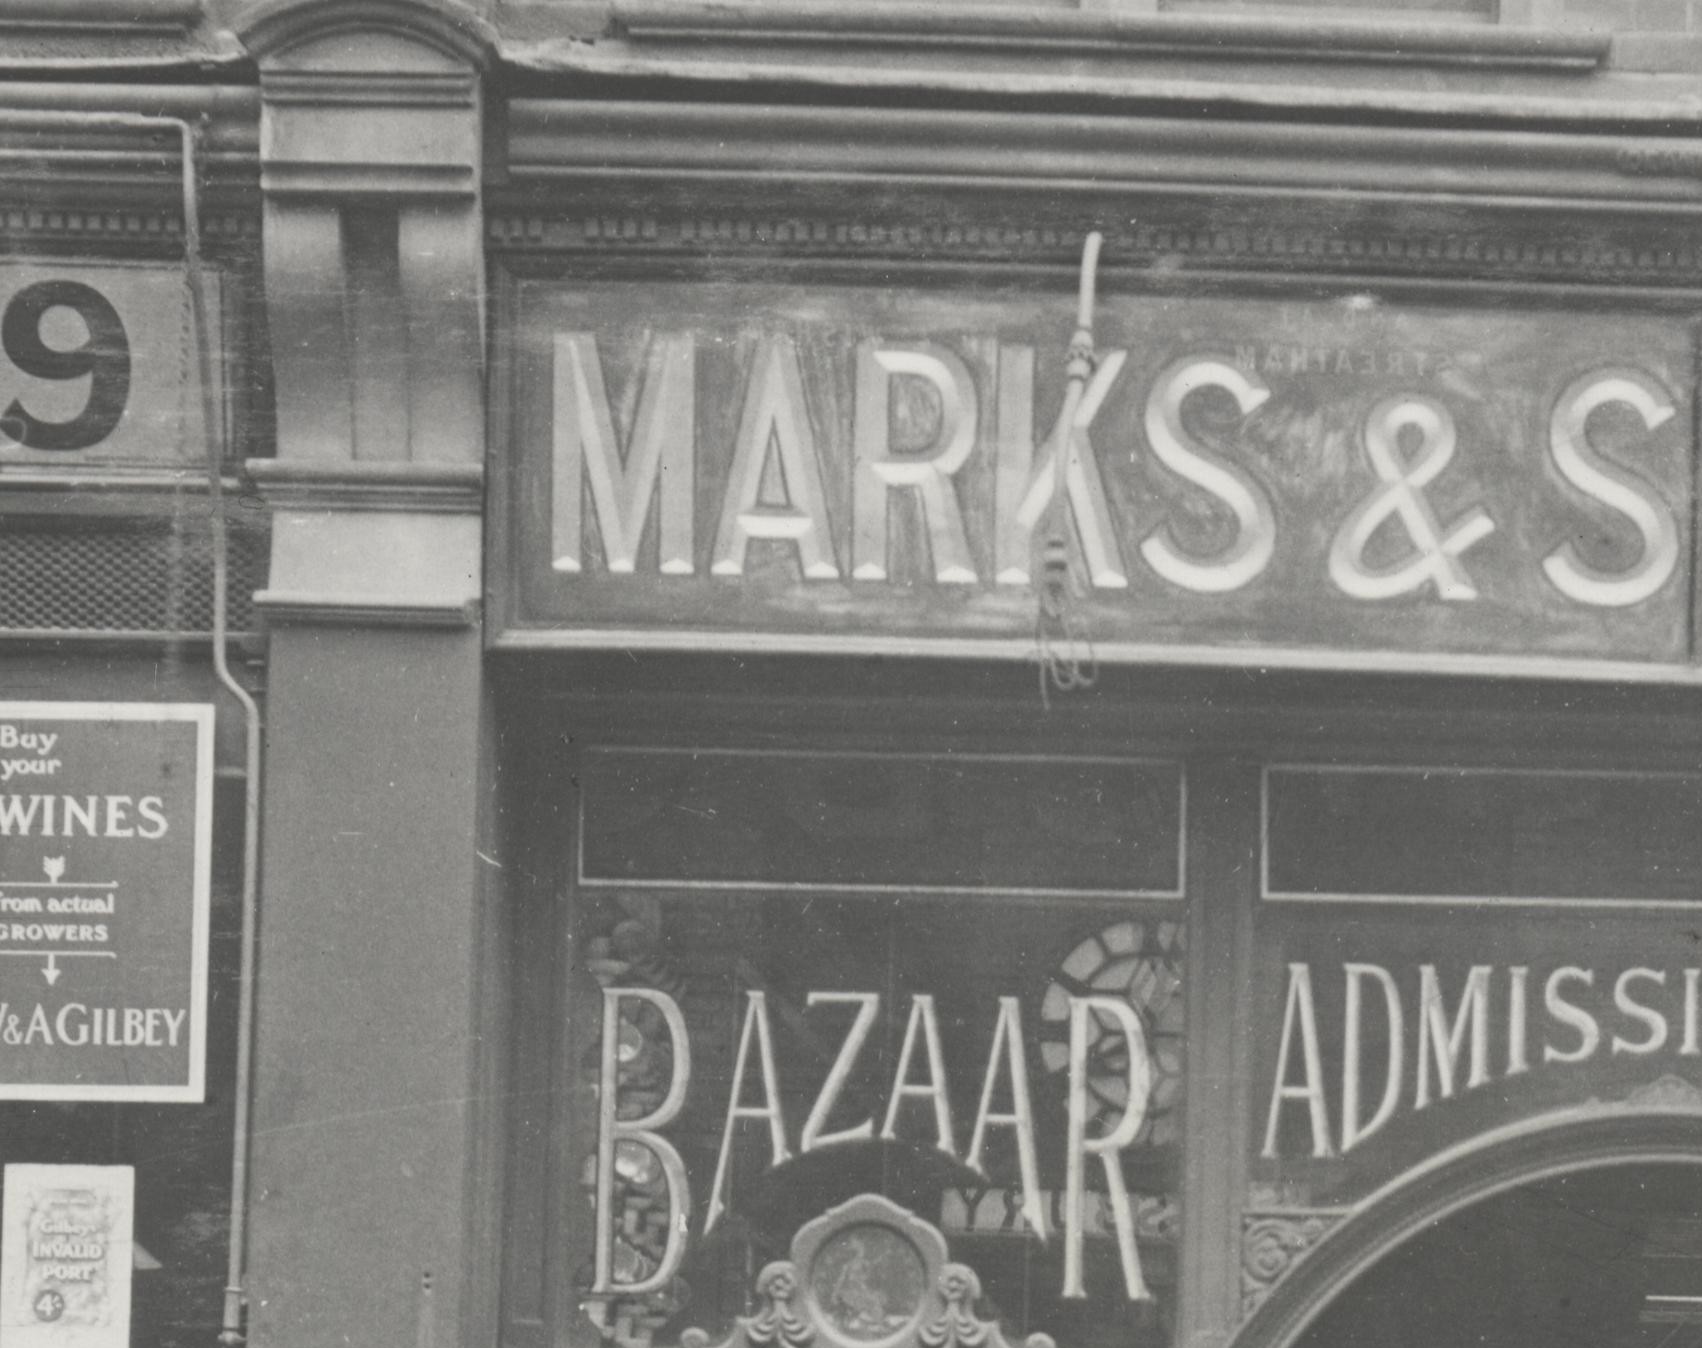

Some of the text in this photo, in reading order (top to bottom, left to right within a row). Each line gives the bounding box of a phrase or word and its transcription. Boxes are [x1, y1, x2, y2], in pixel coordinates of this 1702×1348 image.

[551, 328, 1277, 594] MARKS
[1328, 394, 1497, 601] &
[0, 724, 58, 755] Buy
[0, 758, 62, 781] your
[0, 794, 169, 839] WINES
[0, 890, 114, 913] rom actual
[0, 923, 108, 941] GROWERS
[591, 987, 1157, 1300] BAZAAR
[32, 1239, 103, 1261] INVALID
[42, 1263, 97, 1284] PORT
